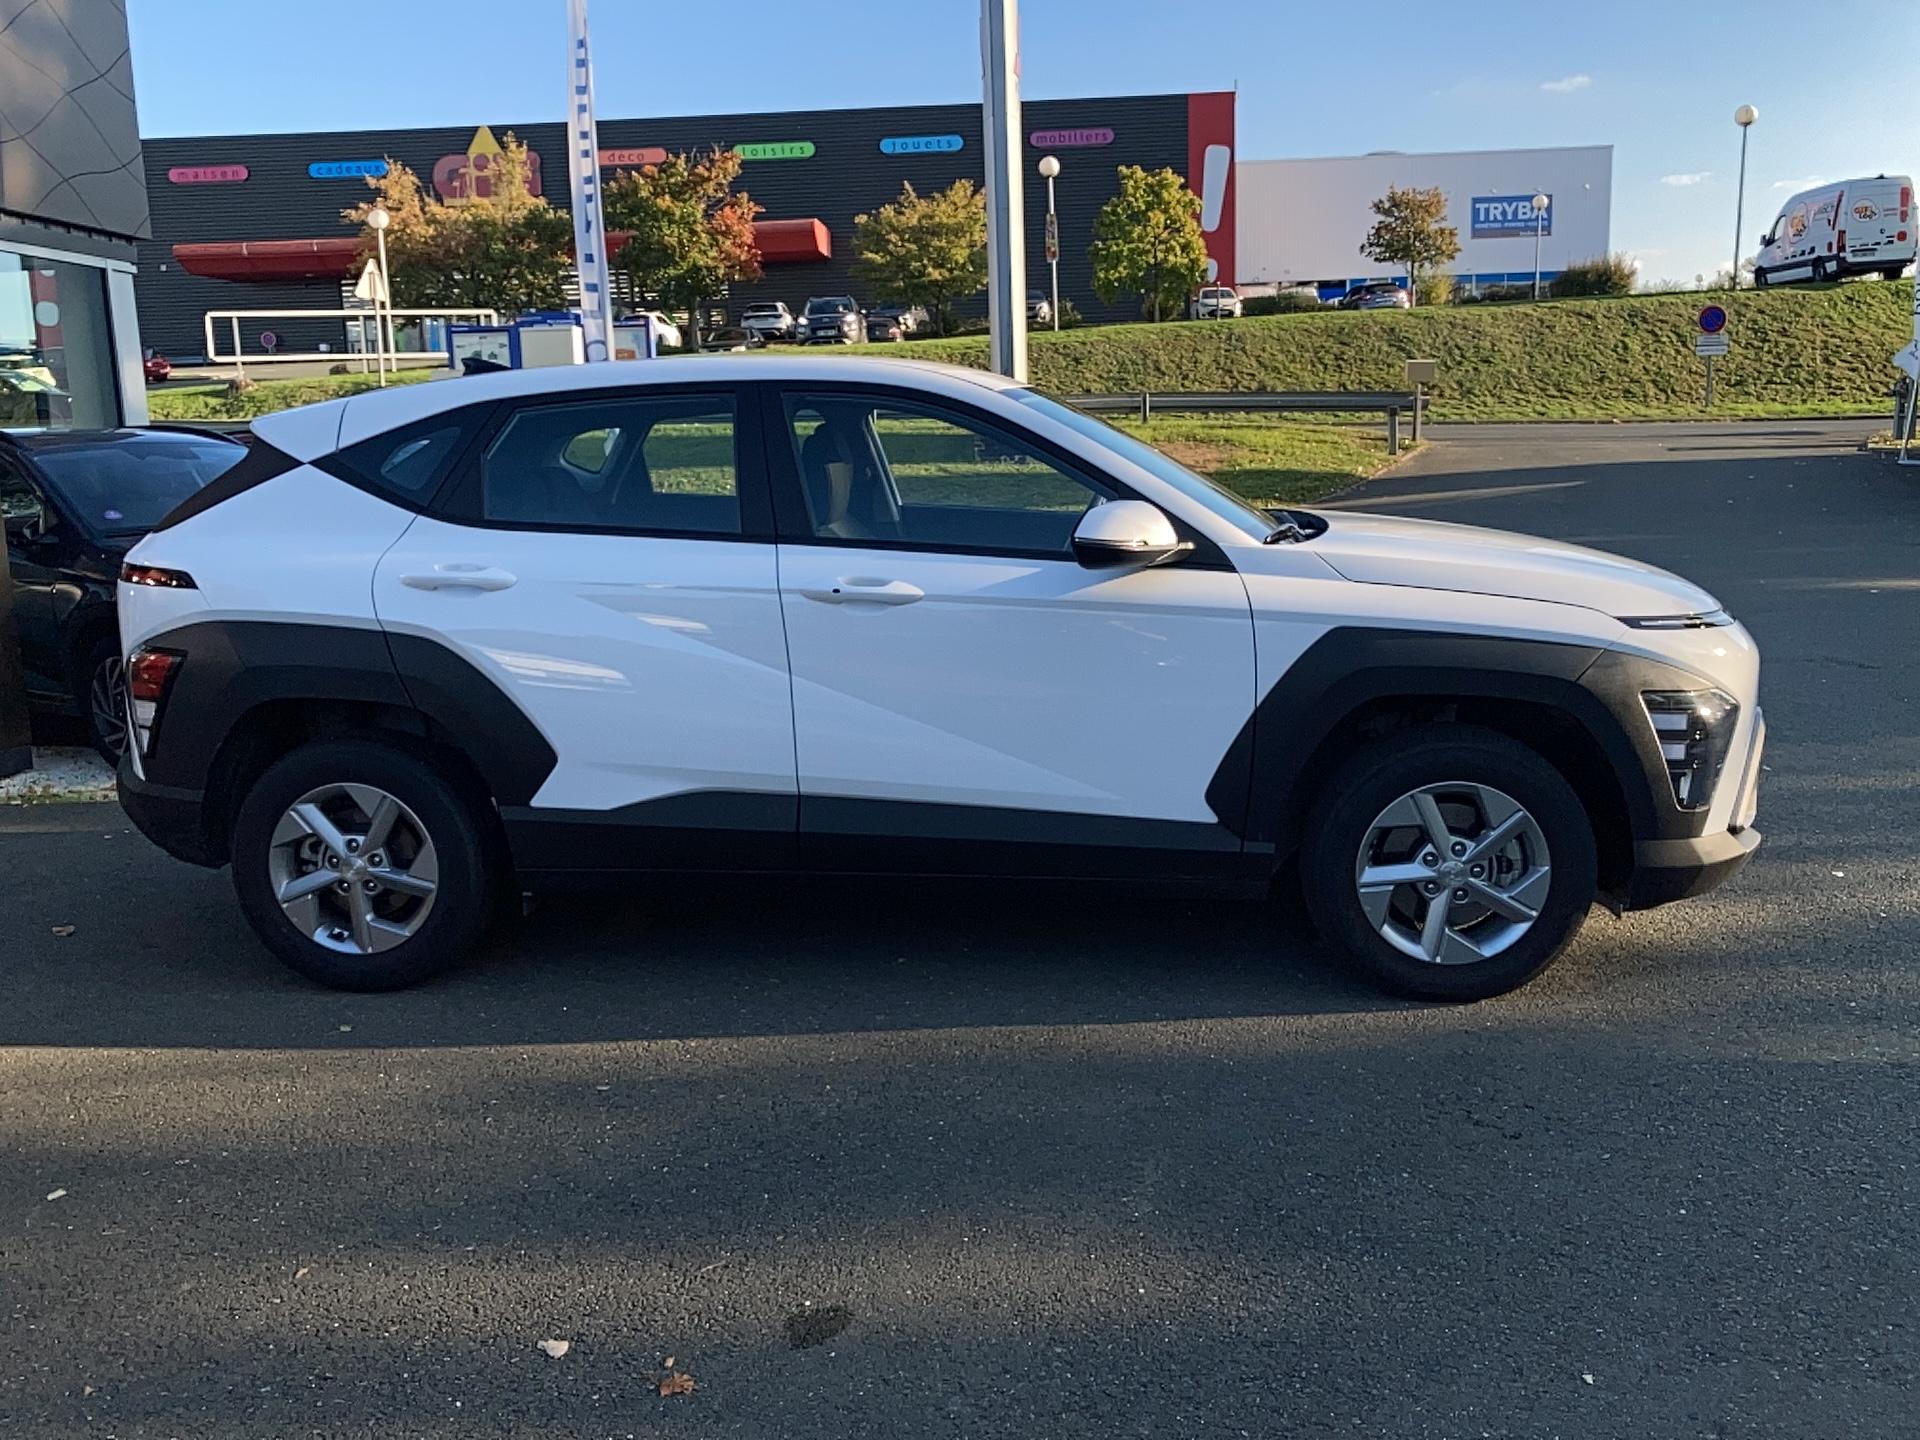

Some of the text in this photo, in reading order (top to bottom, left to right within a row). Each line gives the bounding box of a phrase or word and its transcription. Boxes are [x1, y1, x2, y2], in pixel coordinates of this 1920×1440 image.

[891, 137, 953, 153] jouets
[1036, 131, 1108, 145] mobiliers
[742, 145, 805, 157] loisirs
